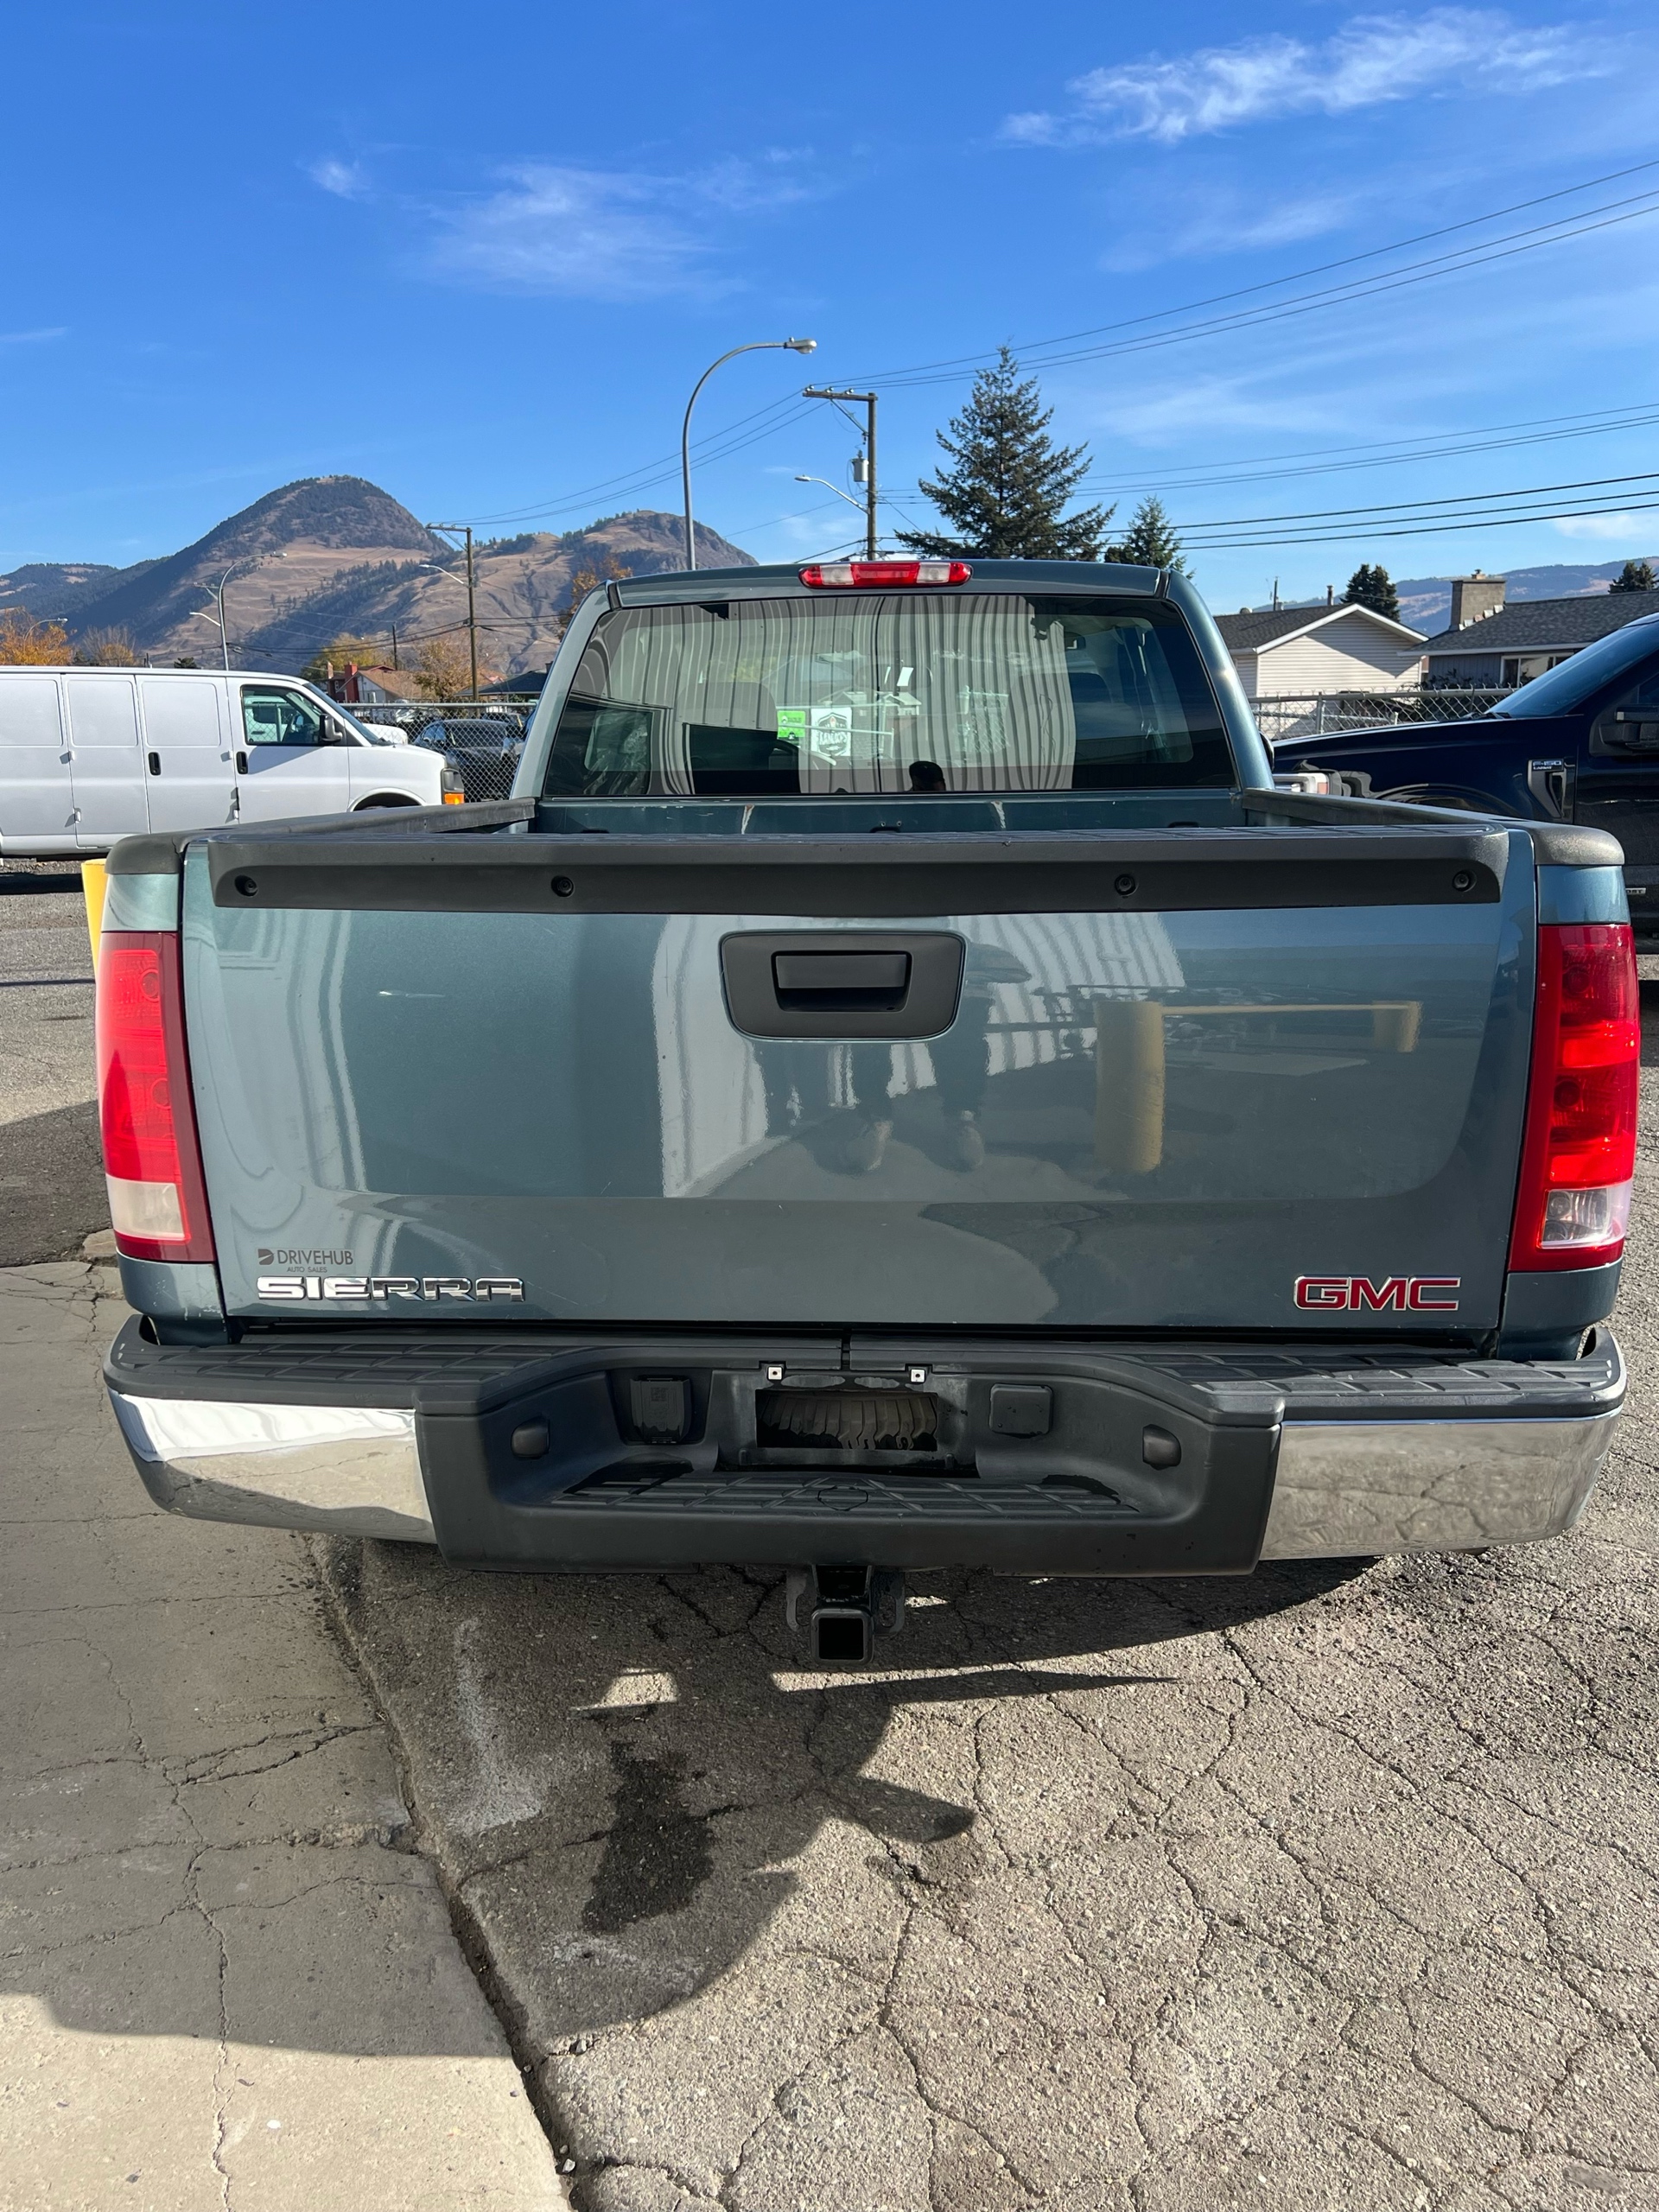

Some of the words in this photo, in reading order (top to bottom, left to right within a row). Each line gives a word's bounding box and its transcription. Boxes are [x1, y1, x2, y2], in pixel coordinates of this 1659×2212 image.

[276, 1249, 353, 1265] DRIVEHUB
[257, 1276, 524, 1302] SIERRA
[1294, 1274, 1461, 1311] GMC
